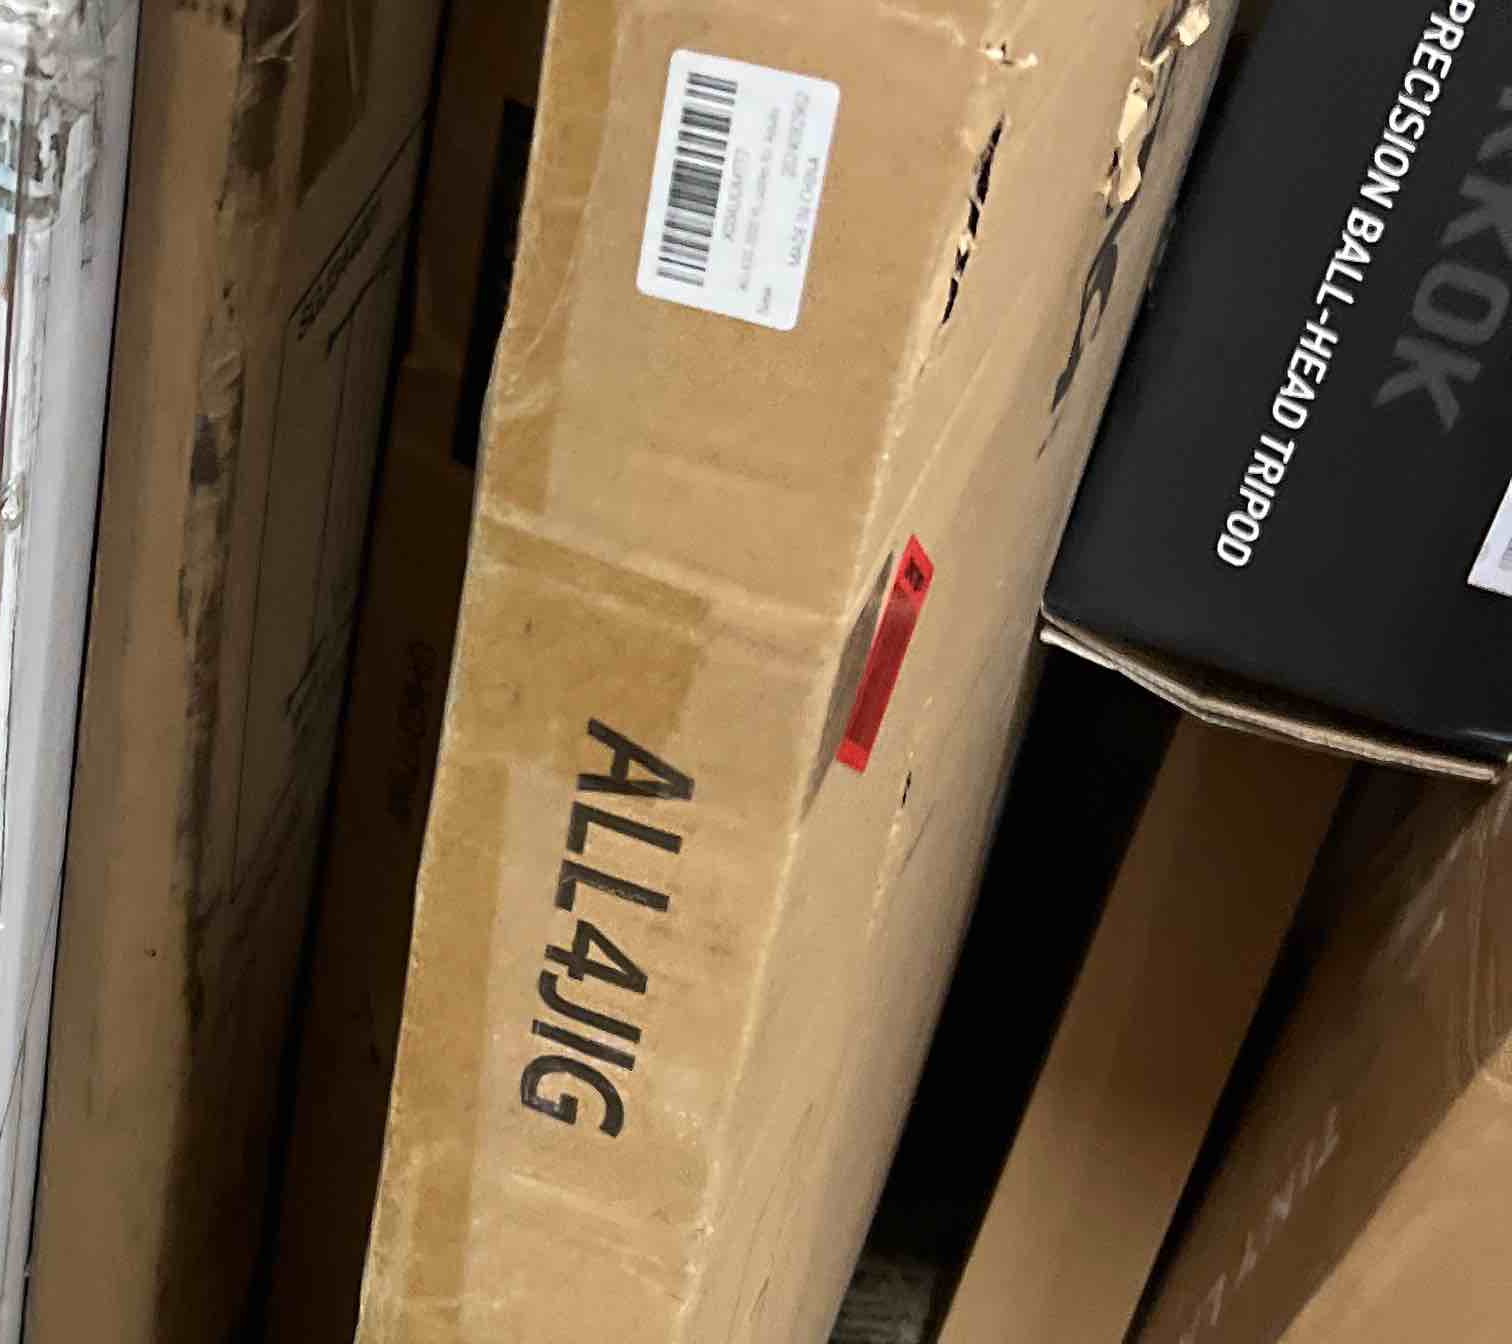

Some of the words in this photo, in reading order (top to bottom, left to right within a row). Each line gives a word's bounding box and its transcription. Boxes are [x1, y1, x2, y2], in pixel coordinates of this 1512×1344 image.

[1271, 205, 1386, 432] BALL-HEAD
[1216, 431, 1296, 569] TRIPOD
[519, 717, 696, 1138] ALL4JIG
